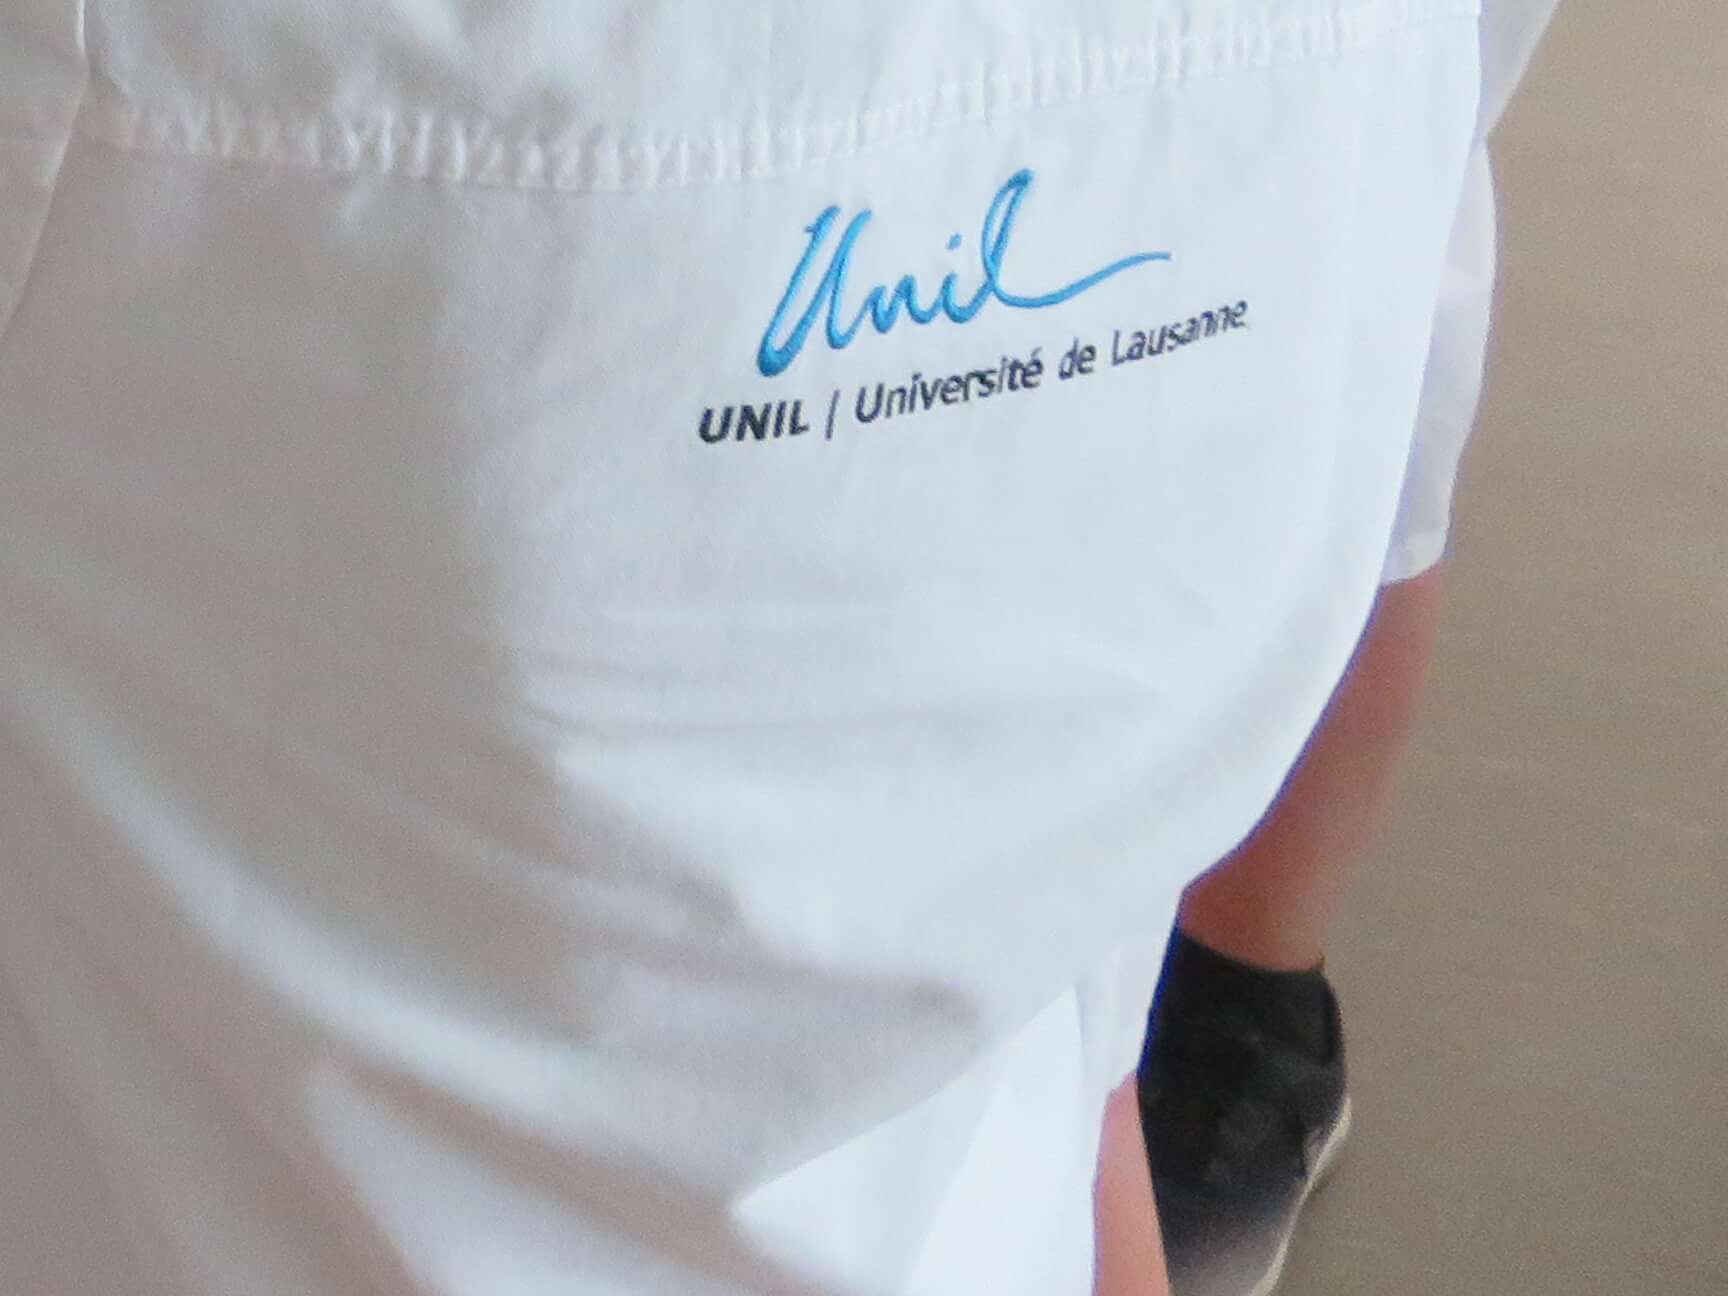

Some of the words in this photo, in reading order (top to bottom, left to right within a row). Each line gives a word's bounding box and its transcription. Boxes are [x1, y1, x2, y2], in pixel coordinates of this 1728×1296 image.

[755, 166, 1172, 377] Unil
[697, 397, 811, 444] UNIL
[854, 356, 1044, 425] Université
[1057, 337, 1098, 381] de
[1109, 297, 1249, 366] Lausanne
